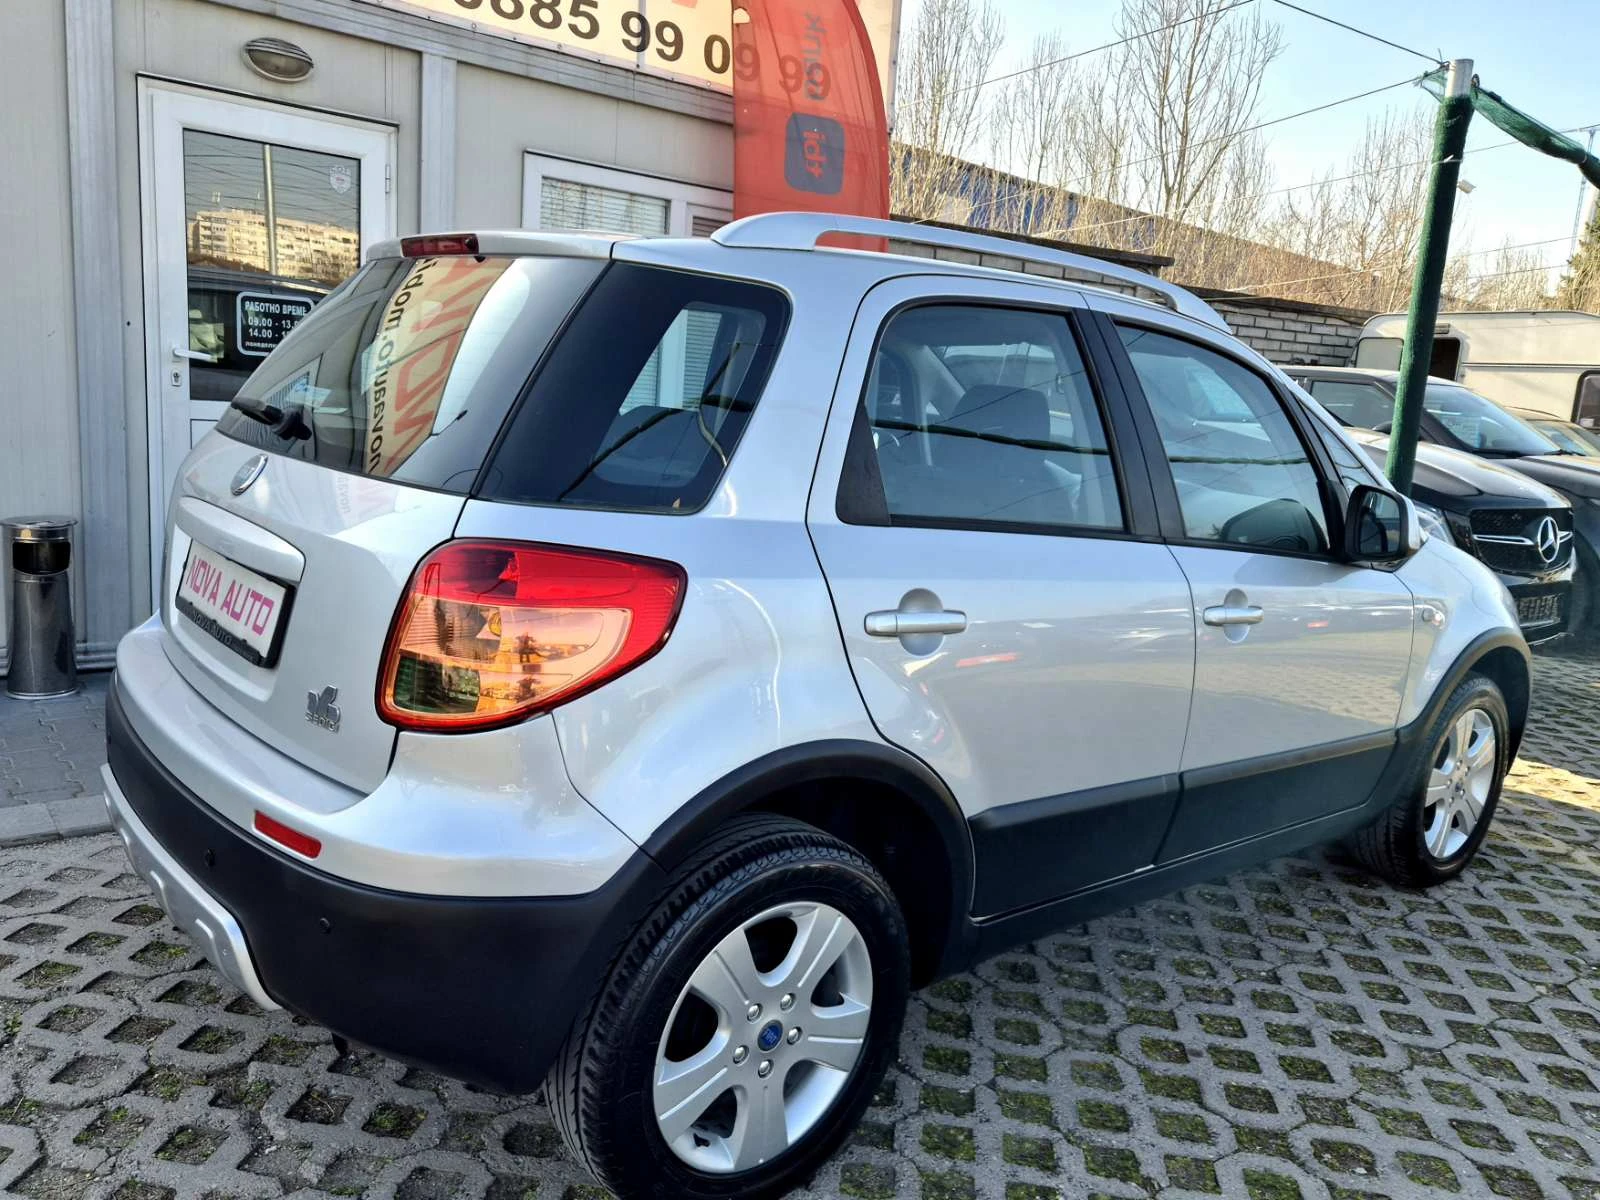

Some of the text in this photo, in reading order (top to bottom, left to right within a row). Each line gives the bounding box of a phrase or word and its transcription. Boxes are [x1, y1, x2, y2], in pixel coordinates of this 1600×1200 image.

[620, 10, 684, 62] 99
[704, 34, 760, 82] 09
[245, 301, 280, 314] РАБОТНО
[248, 317, 273, 327] 09.00
[248, 328, 273, 338] 14.00
[186, 554, 275, 636] NOVA AUTO
